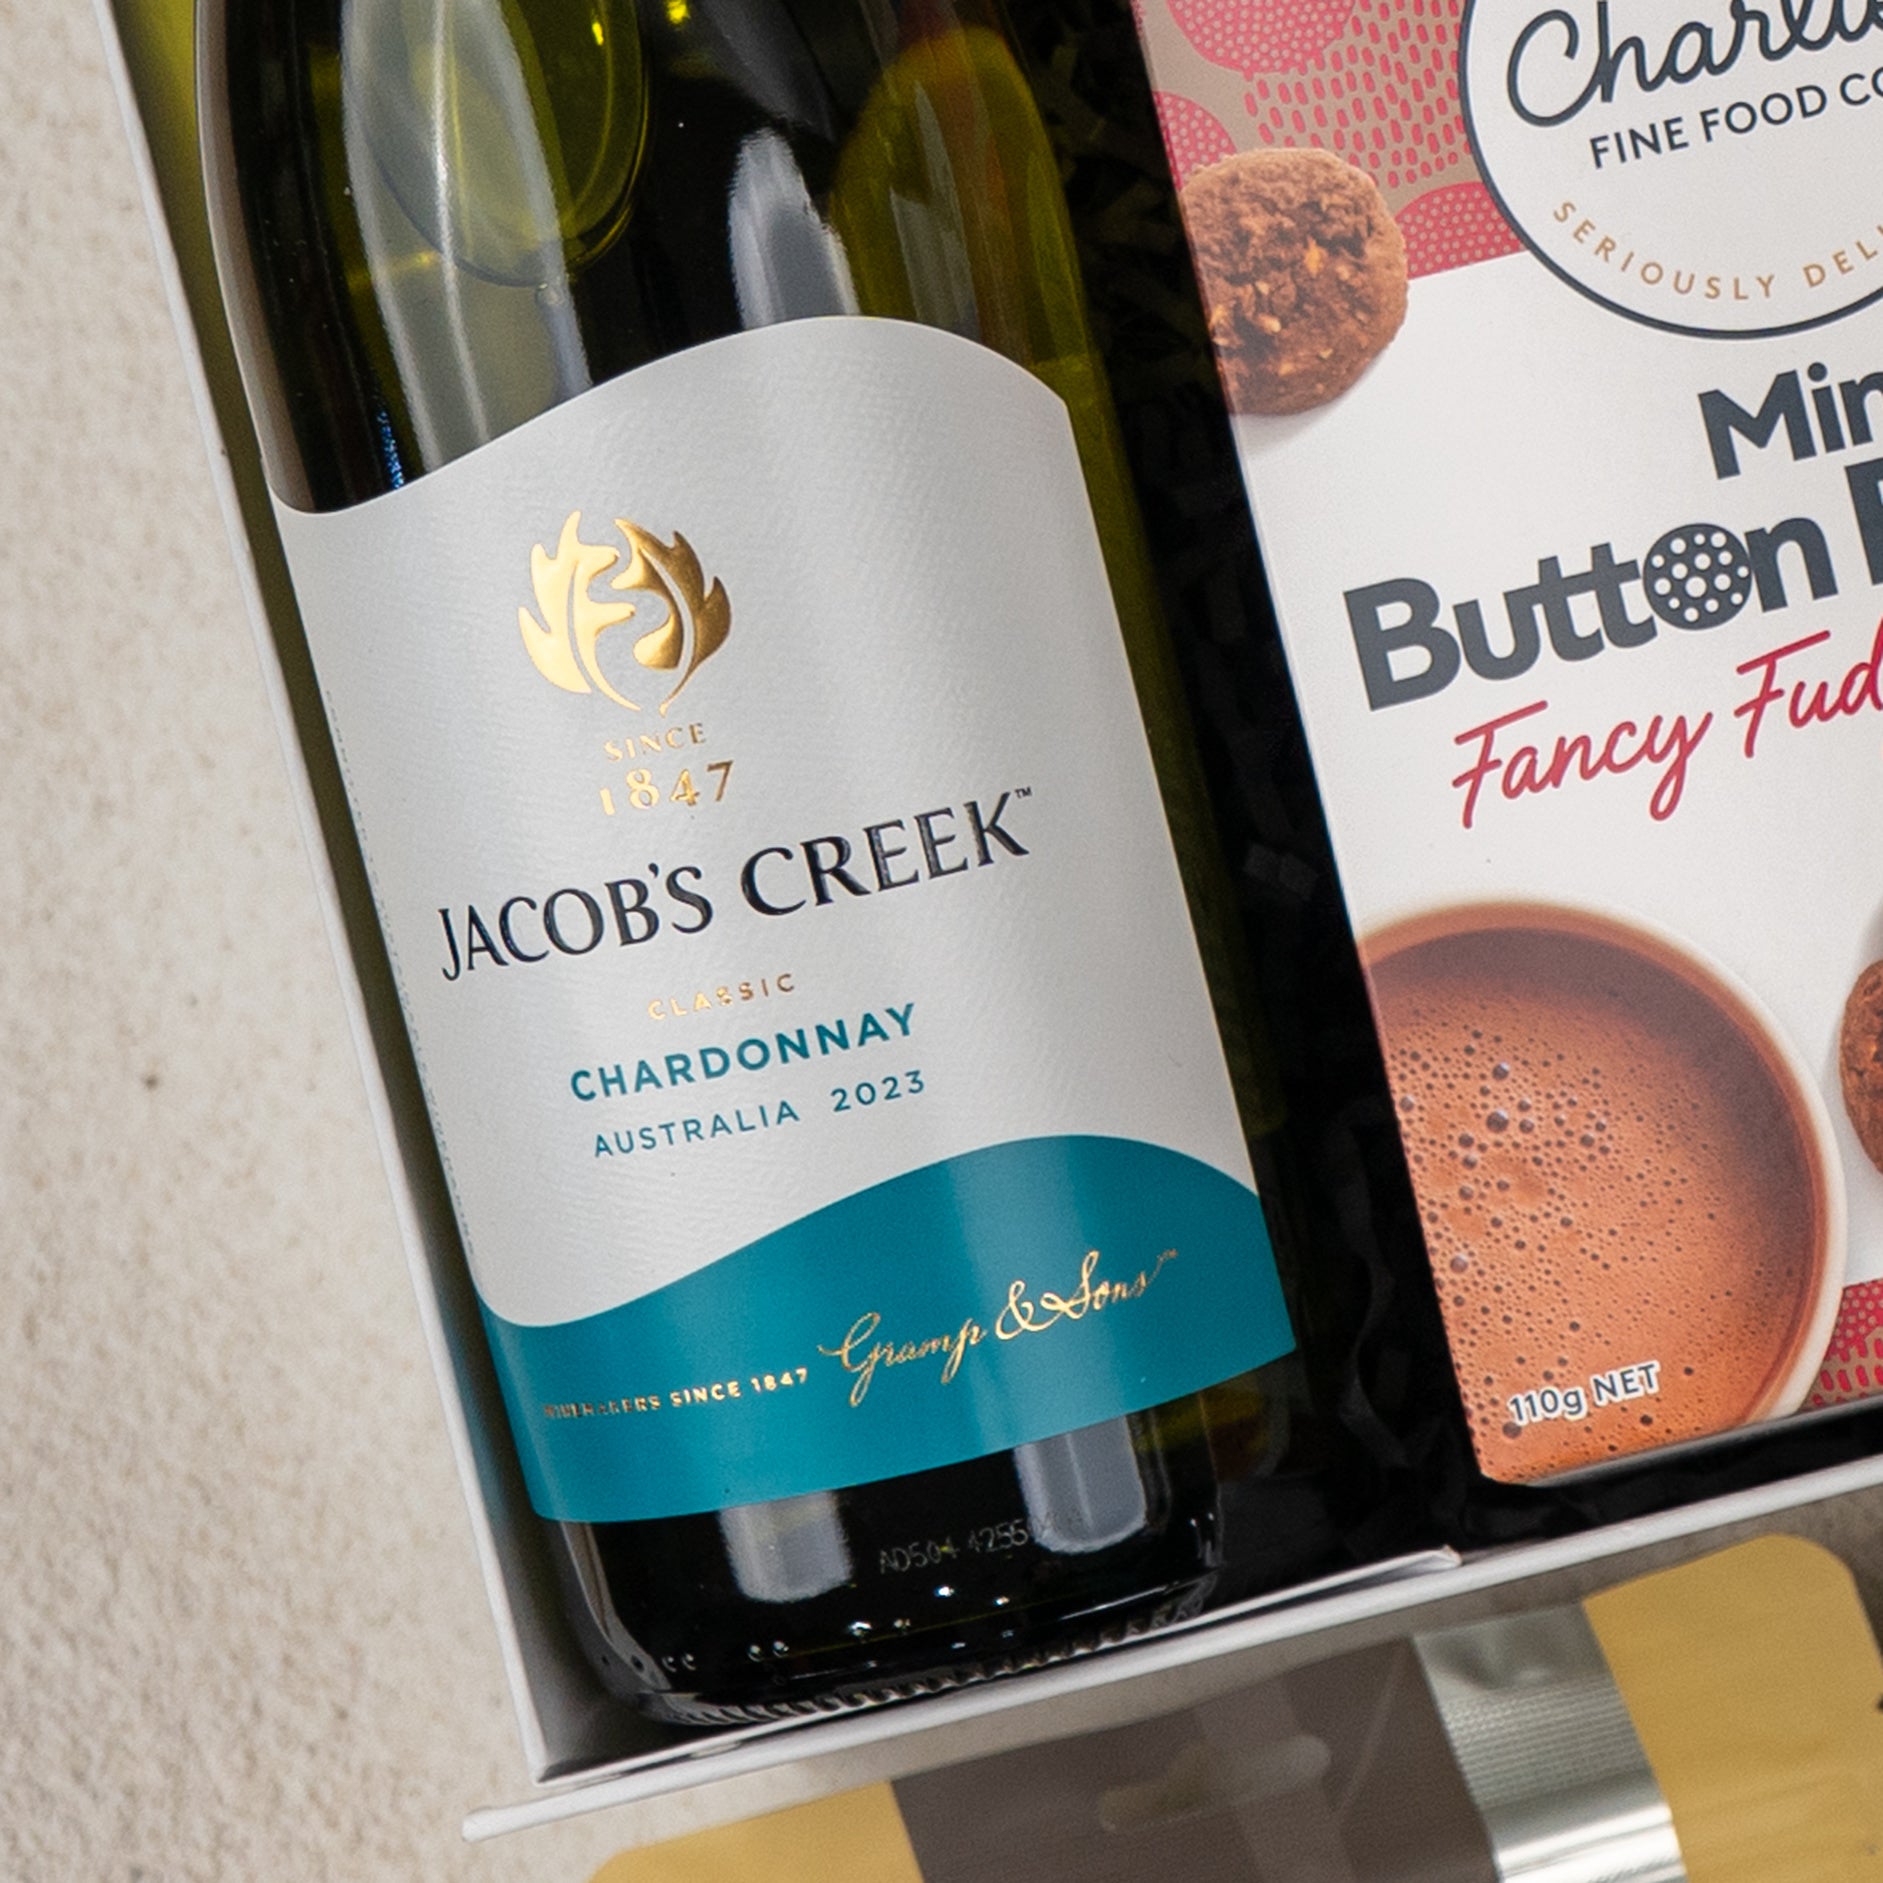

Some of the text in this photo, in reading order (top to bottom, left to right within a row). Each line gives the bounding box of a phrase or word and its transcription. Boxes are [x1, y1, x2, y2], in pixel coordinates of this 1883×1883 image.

[1590, 117, 1689, 169] FINE
[1700, 85, 1827, 142] FOOD
[1553, 201, 1775, 301] SERIOUSLY
[1343, 517, 1838, 711] Button
[604, 722, 706, 762] SINCE
[1452, 700, 1713, 829] Fancy
[600, 760, 733, 815] 1847
[438, 863, 713, 981] JACOB'S
[648, 973, 795, 1020] CLASSIC
[570, 1003, 915, 1101] CHARDONNAY
[594, 1069, 925, 1158] AUSTRALIA 2023
[669, 1380, 742, 1408] SINCE
[751, 1367, 808, 1393] 1847
[817, 1311, 987, 1407] Gramp
[1510, 1363, 1655, 1421] 110g NET
